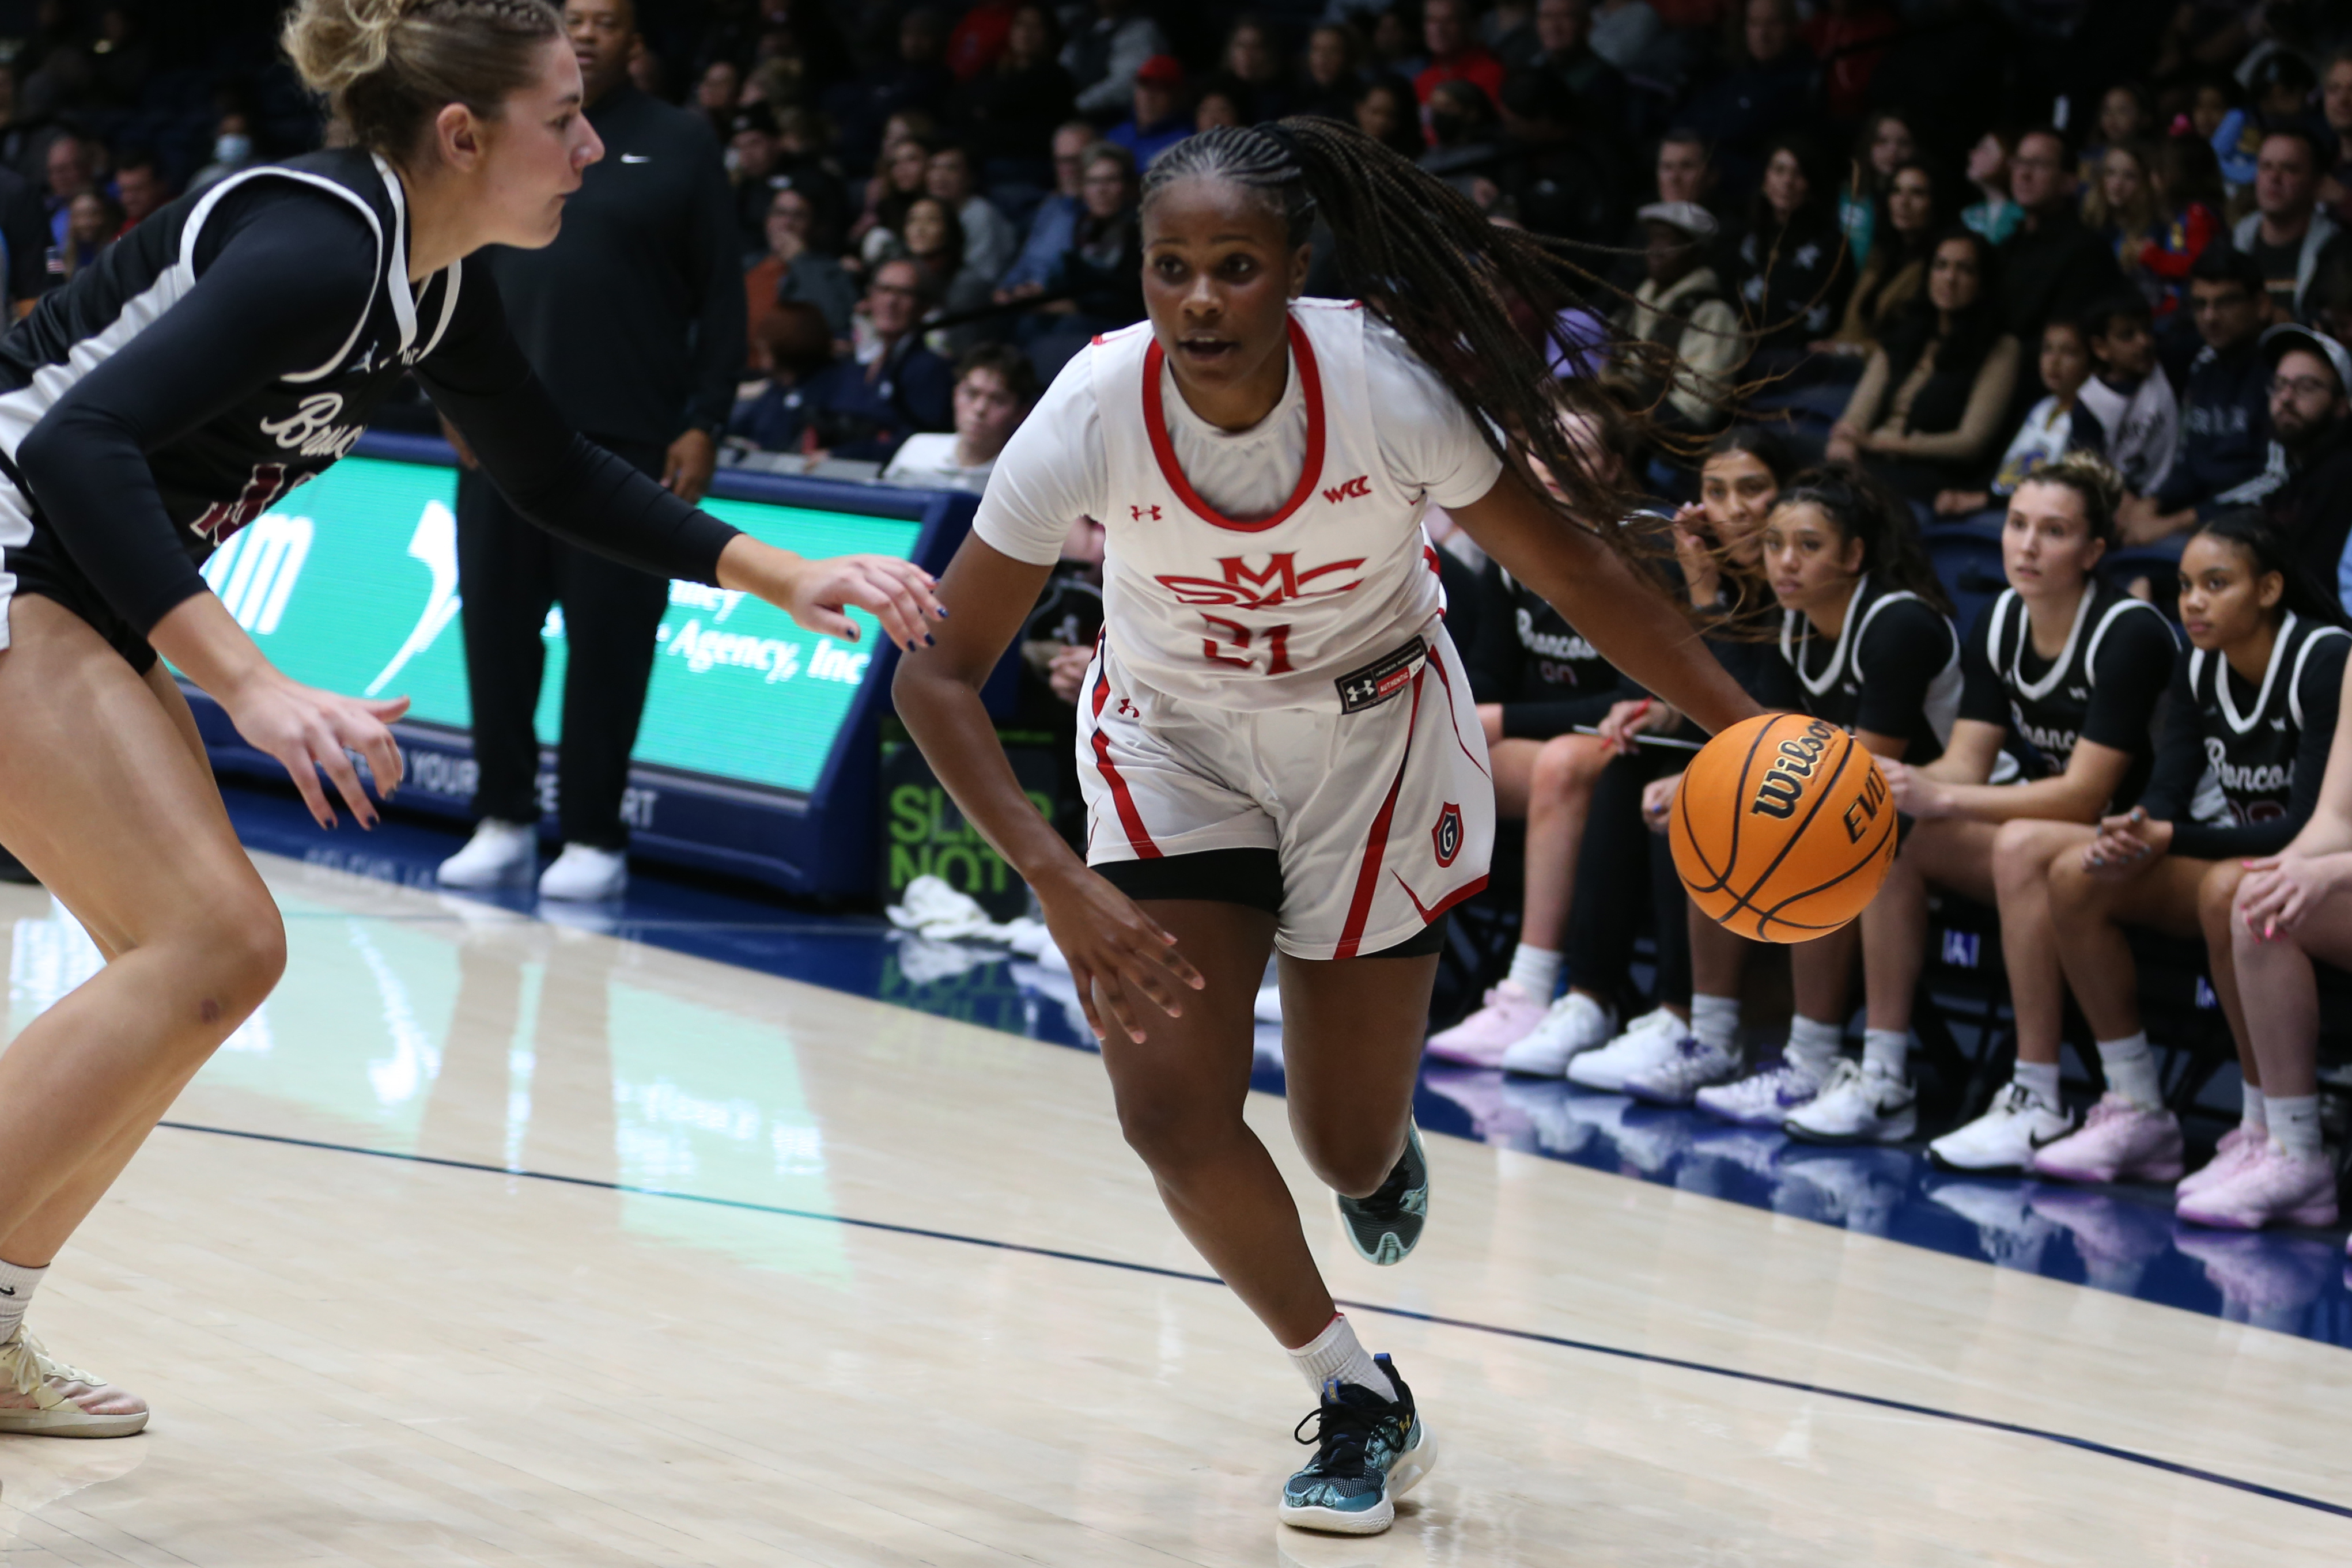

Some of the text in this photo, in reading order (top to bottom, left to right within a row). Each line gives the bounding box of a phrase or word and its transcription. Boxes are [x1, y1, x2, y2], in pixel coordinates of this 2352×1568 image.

[1322, 475, 1372, 504] WCC
[1154, 548, 1370, 611] SMC
[667, 619, 801, 684] Agency,
[1198, 611, 1296, 675] 21
[1380, 672, 1409, 692] AUTHENTIC
